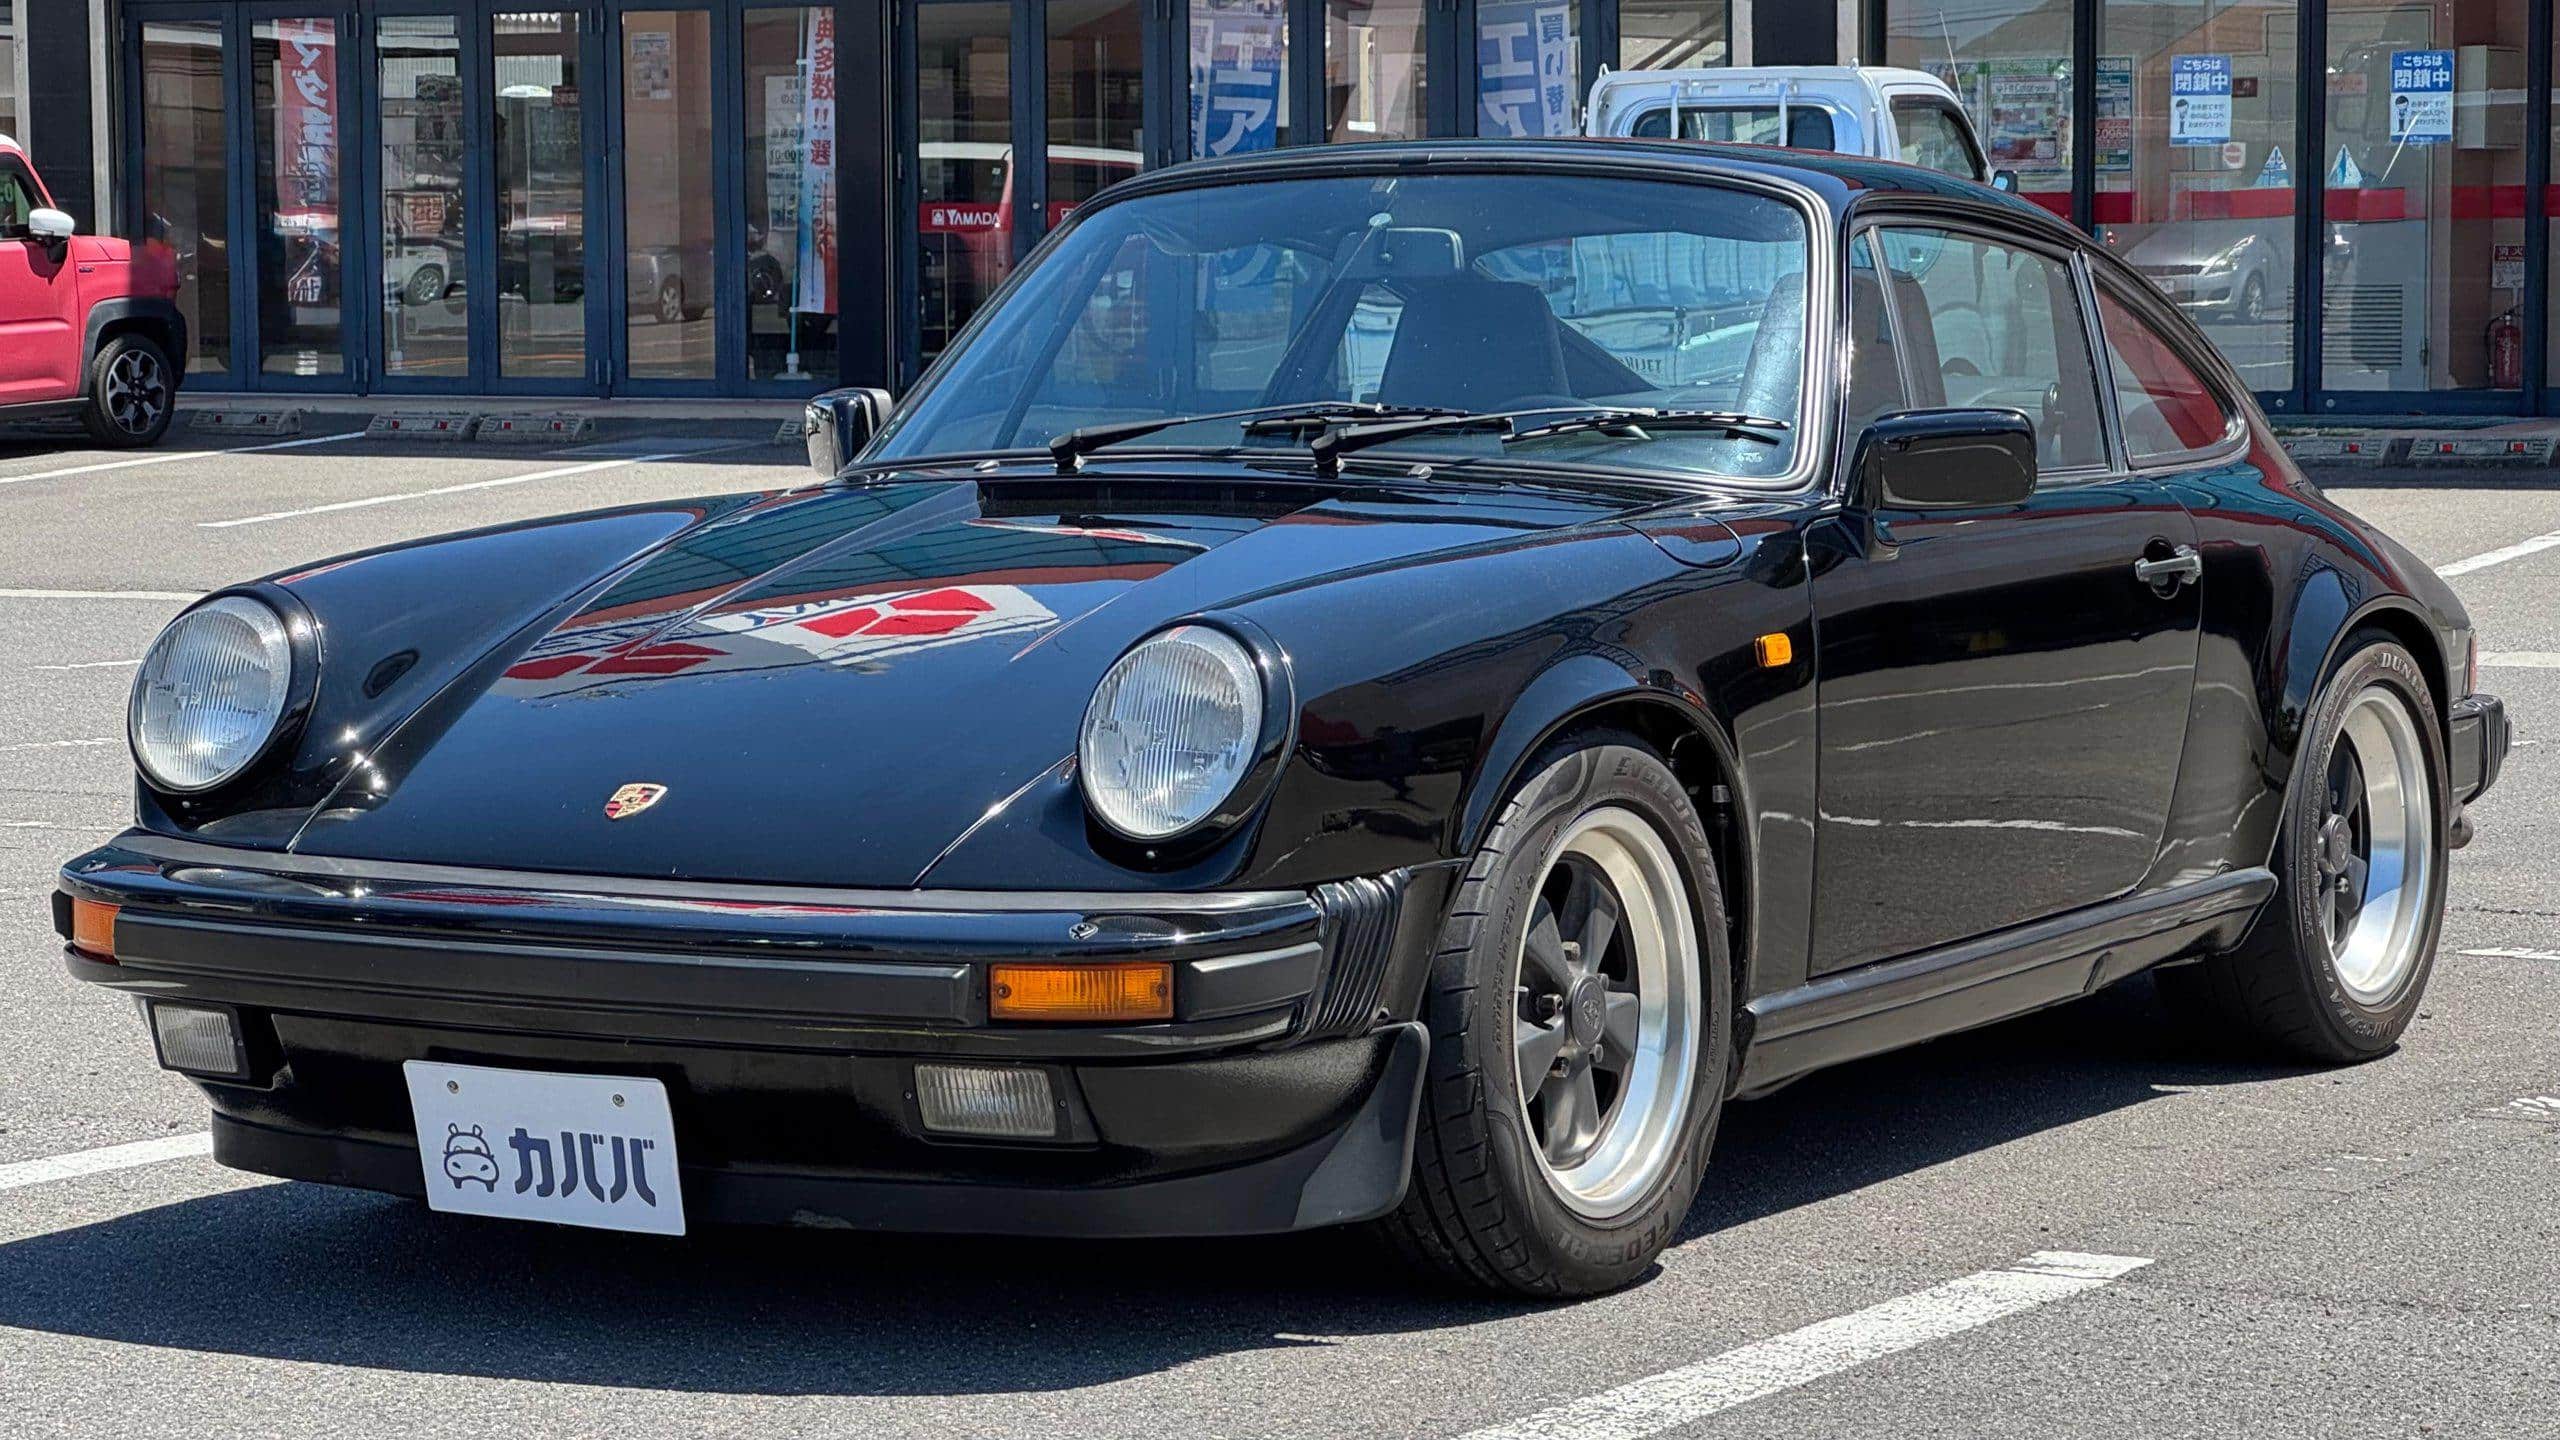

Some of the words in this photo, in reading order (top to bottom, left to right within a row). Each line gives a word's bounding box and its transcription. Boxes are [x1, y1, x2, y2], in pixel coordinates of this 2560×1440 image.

[2182, 59, 2222, 71] こちらは
[2402, 55, 2443, 67] こちらは
[2174, 71, 2229, 92] 閉鎖中
[2394, 68, 2450, 88] 閉鎖中
[947, 208, 1000, 225] YAMADA
[508, 1127, 657, 1208] カババ
